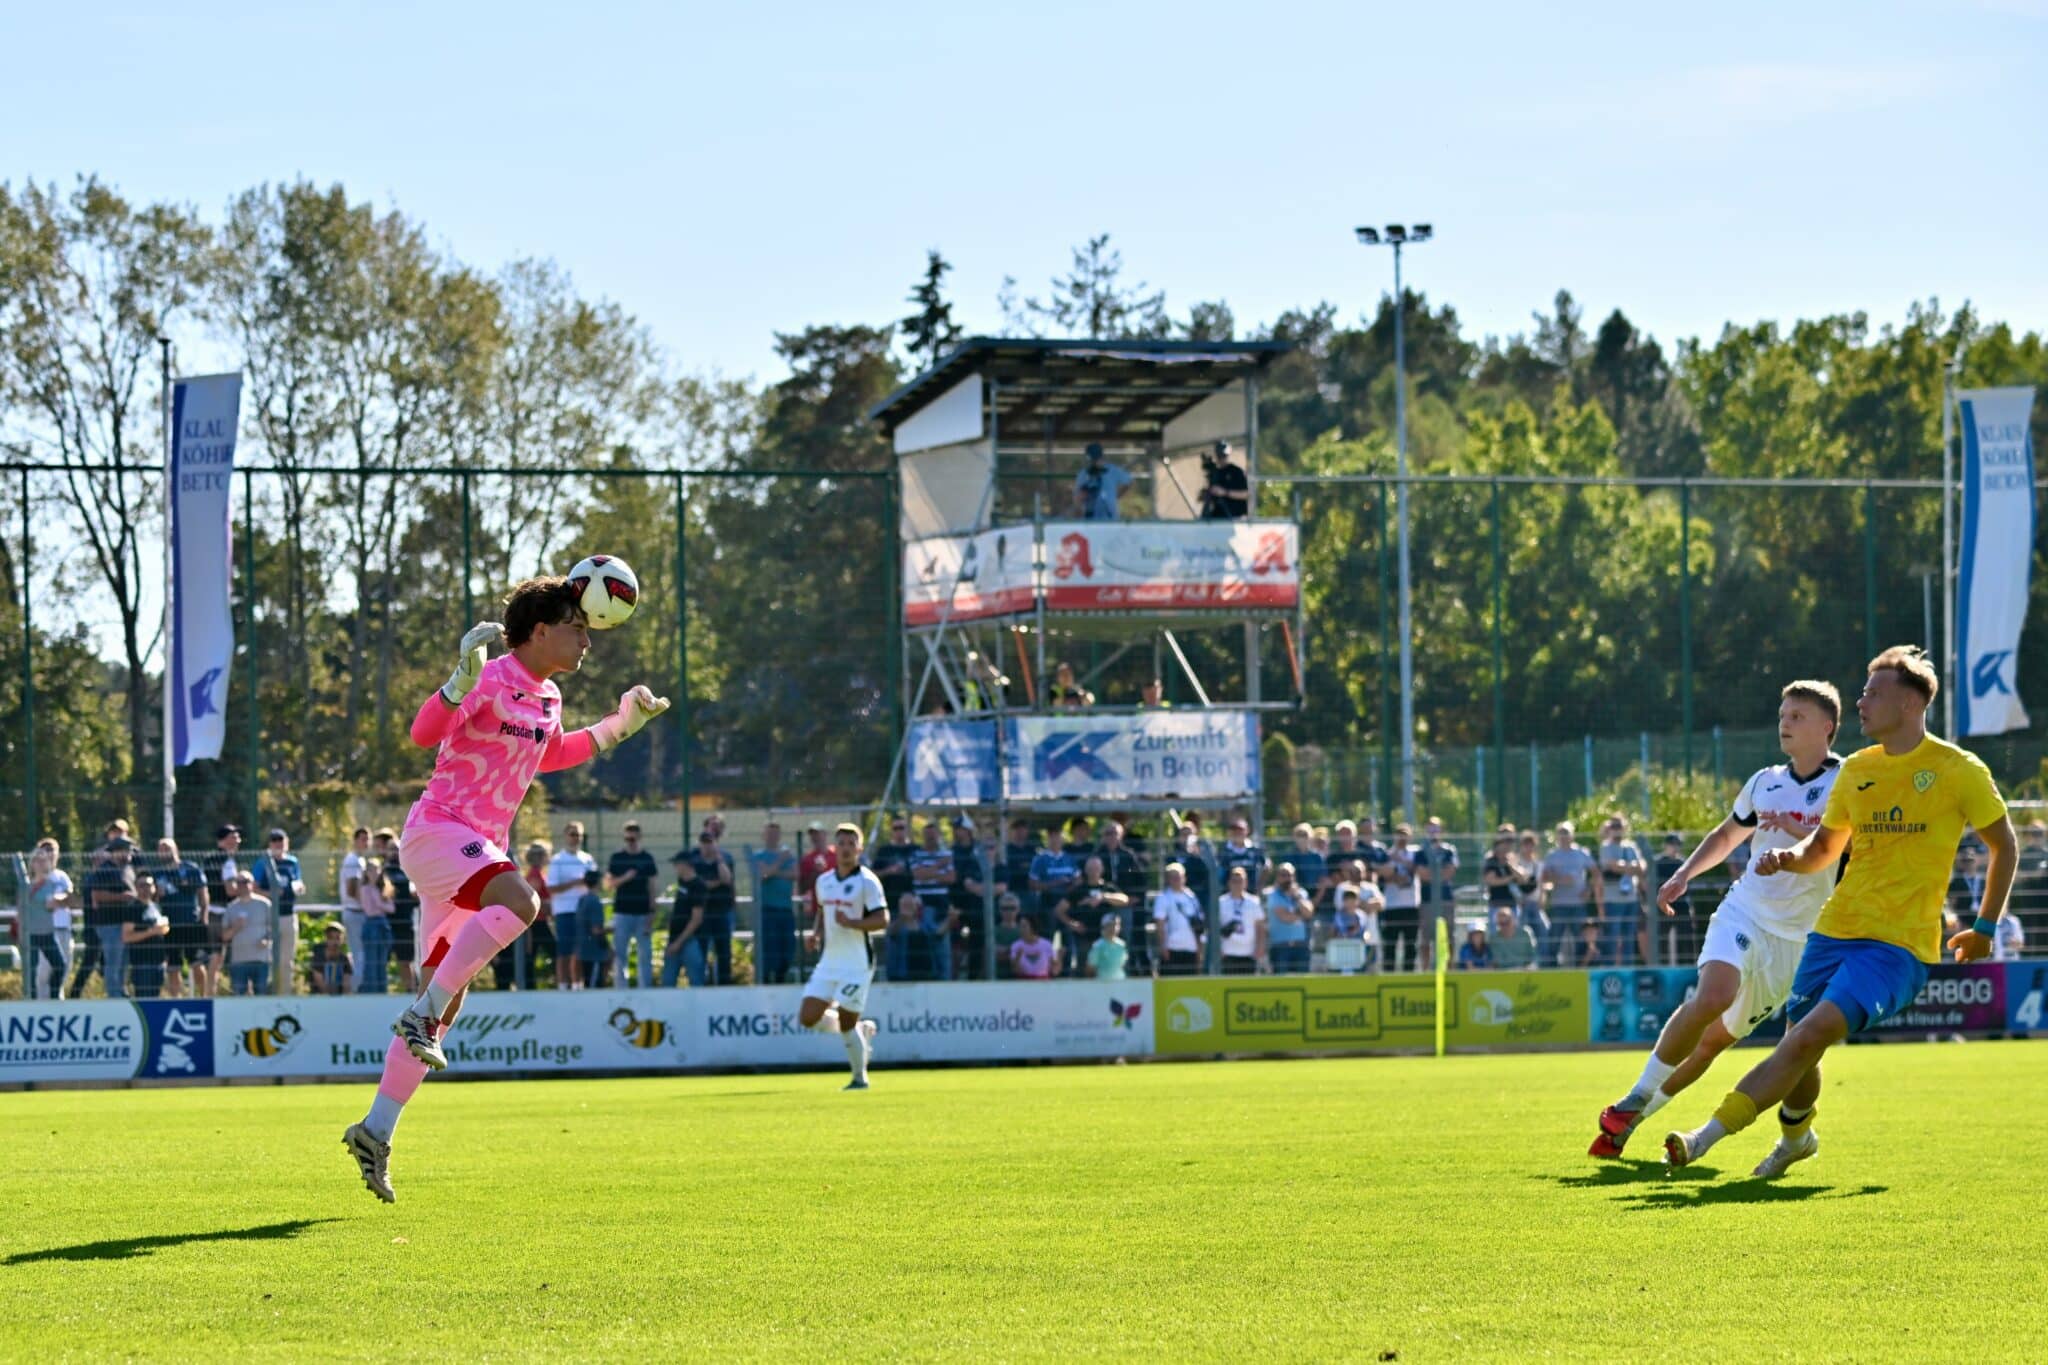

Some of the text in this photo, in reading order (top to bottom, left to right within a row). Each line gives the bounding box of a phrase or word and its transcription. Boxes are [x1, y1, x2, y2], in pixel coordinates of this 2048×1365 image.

[500, 721, 534, 740] Potsdam
[1133, 756, 1232, 778] in Beton
[1872, 811, 1888, 821] DIE
[888, 1010, 1035, 1033] Luckenwalde
[1235, 1000, 1296, 1023] Stadt.
[1315, 1008, 1371, 1029] Land.
[0, 1014, 131, 1043] NSKI.cc
[452, 1013, 536, 1043] ayer
